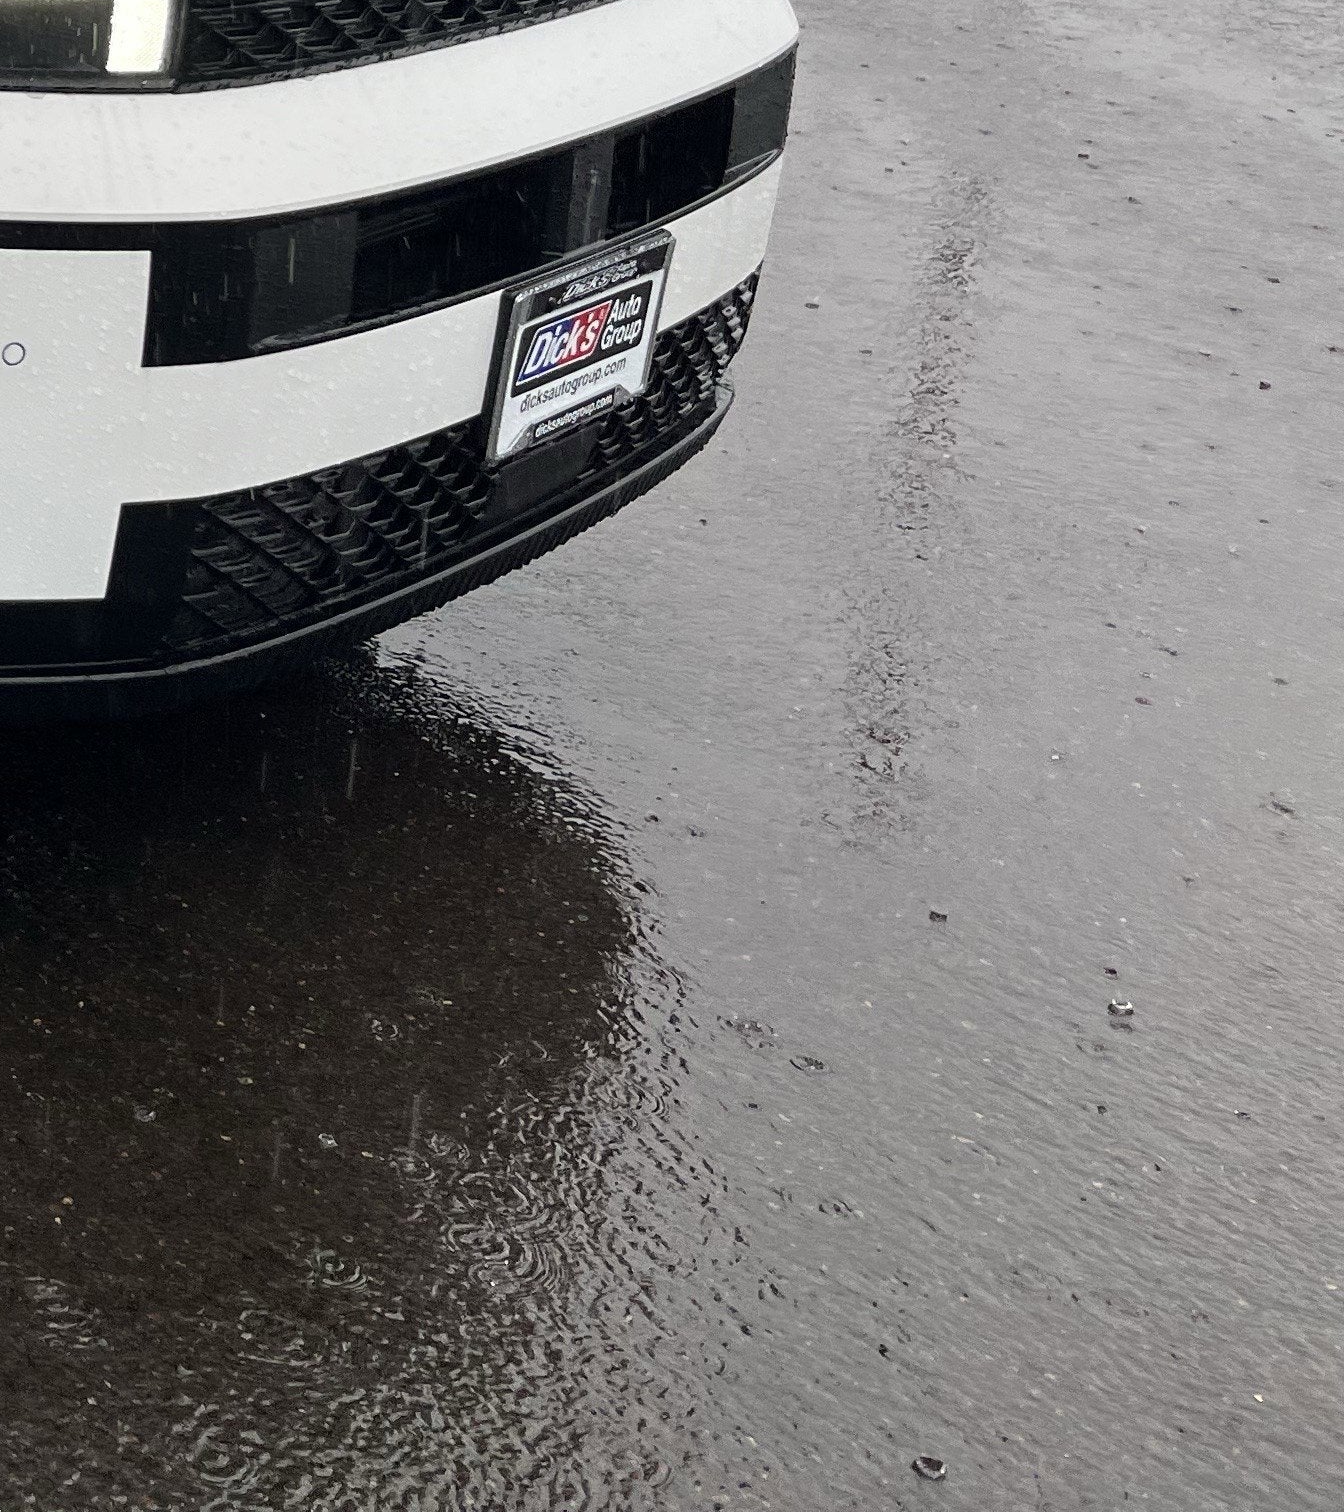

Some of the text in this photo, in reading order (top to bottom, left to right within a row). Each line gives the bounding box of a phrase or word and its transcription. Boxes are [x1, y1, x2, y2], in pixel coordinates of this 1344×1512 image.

[524, 294, 642, 375] Dick's Auto
[600, 319, 642, 350] Group
[520, 357, 627, 413] dicksautogroup.com
[535, 394, 613, 438] dicksautogroup.com
